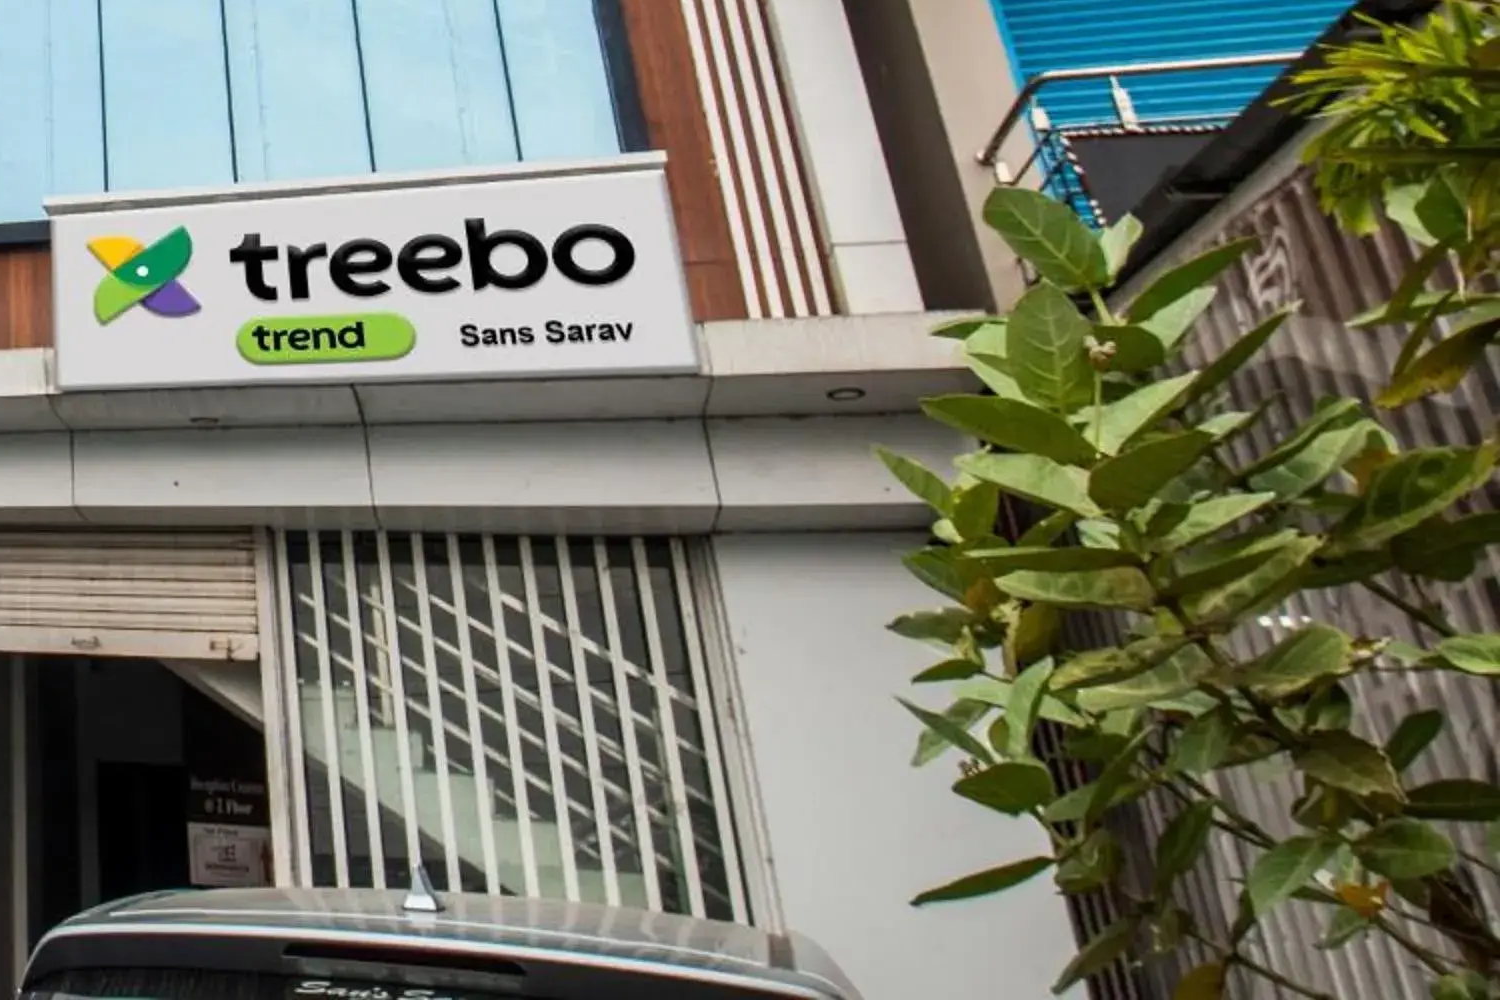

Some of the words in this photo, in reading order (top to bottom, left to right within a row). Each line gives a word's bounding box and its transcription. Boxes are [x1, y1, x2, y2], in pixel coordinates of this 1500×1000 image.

[230, 217, 636, 300] treebo
[252, 321, 366, 352] trend
[459, 321, 535, 348] Sans
[544, 318, 635, 344] Sarav
